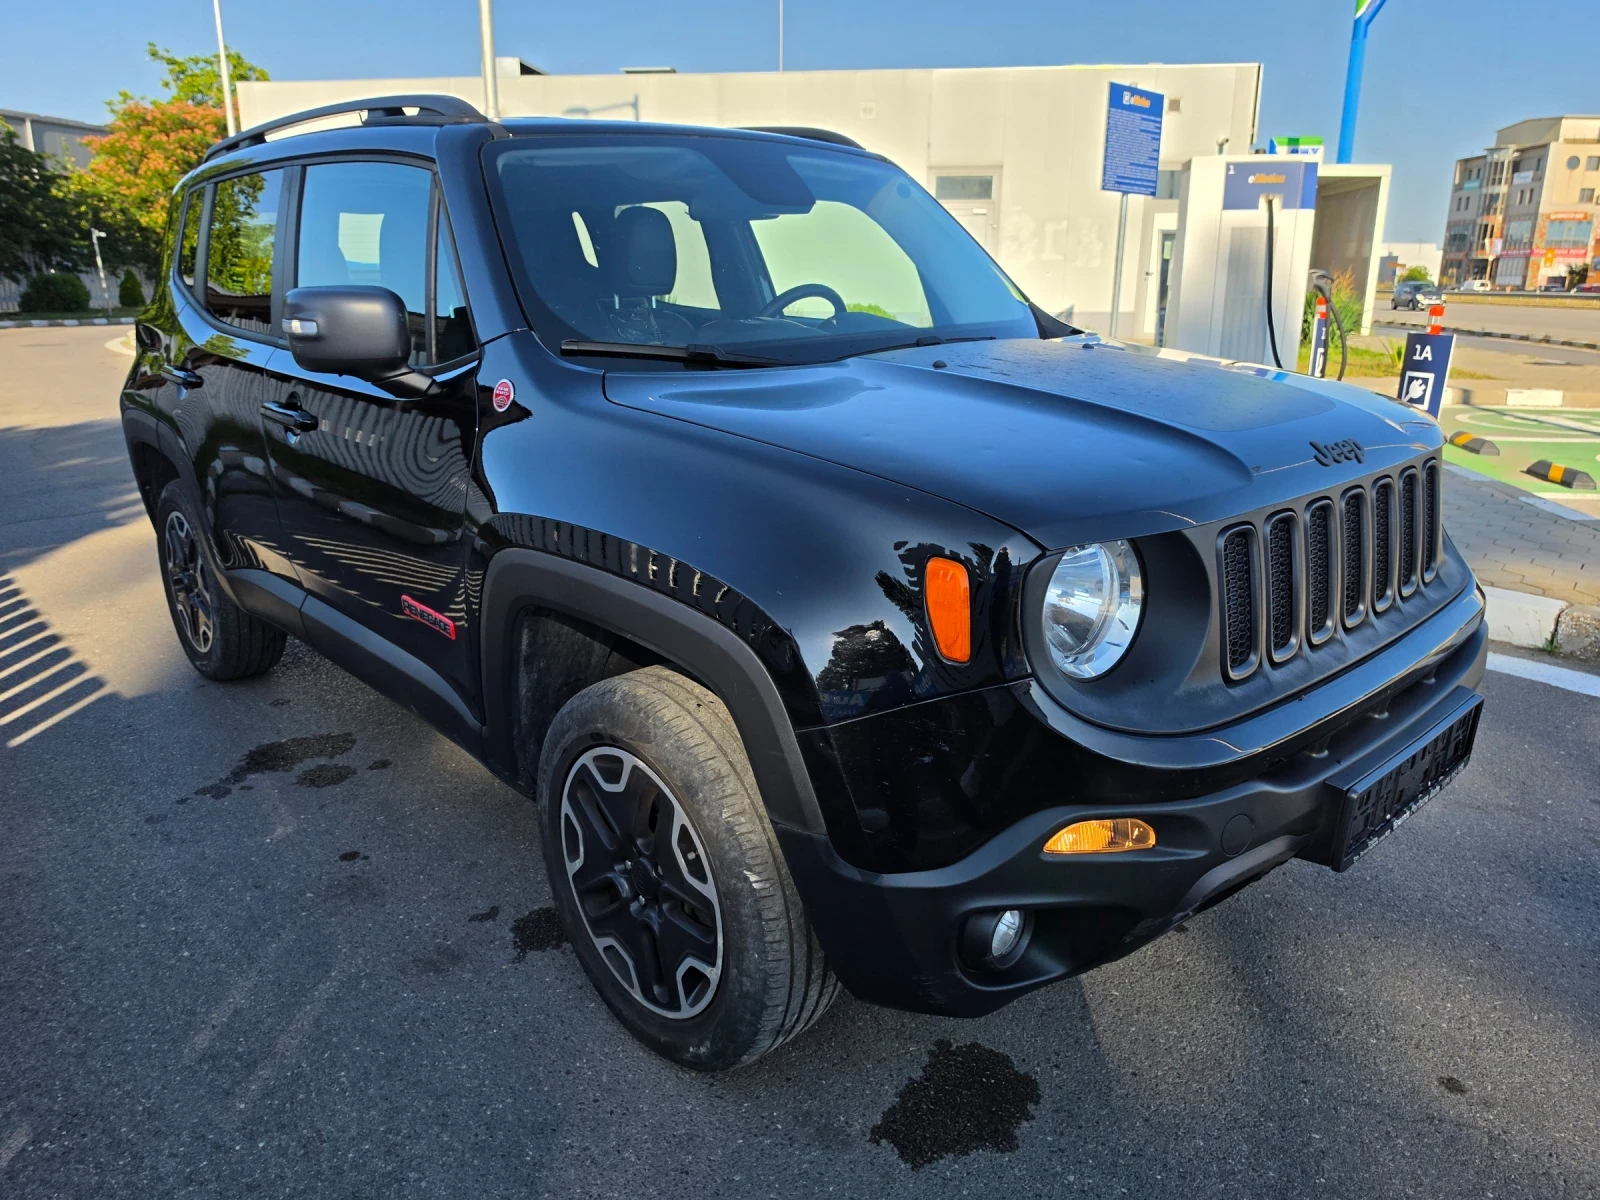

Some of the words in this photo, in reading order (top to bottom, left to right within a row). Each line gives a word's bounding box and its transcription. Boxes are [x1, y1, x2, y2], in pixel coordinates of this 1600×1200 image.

[1229, 165, 1236, 175] 1
[1413, 344, 1432, 361] 1A
[1309, 438, 1366, 467] Jeep
[403, 600, 451, 635] RENEGADE
